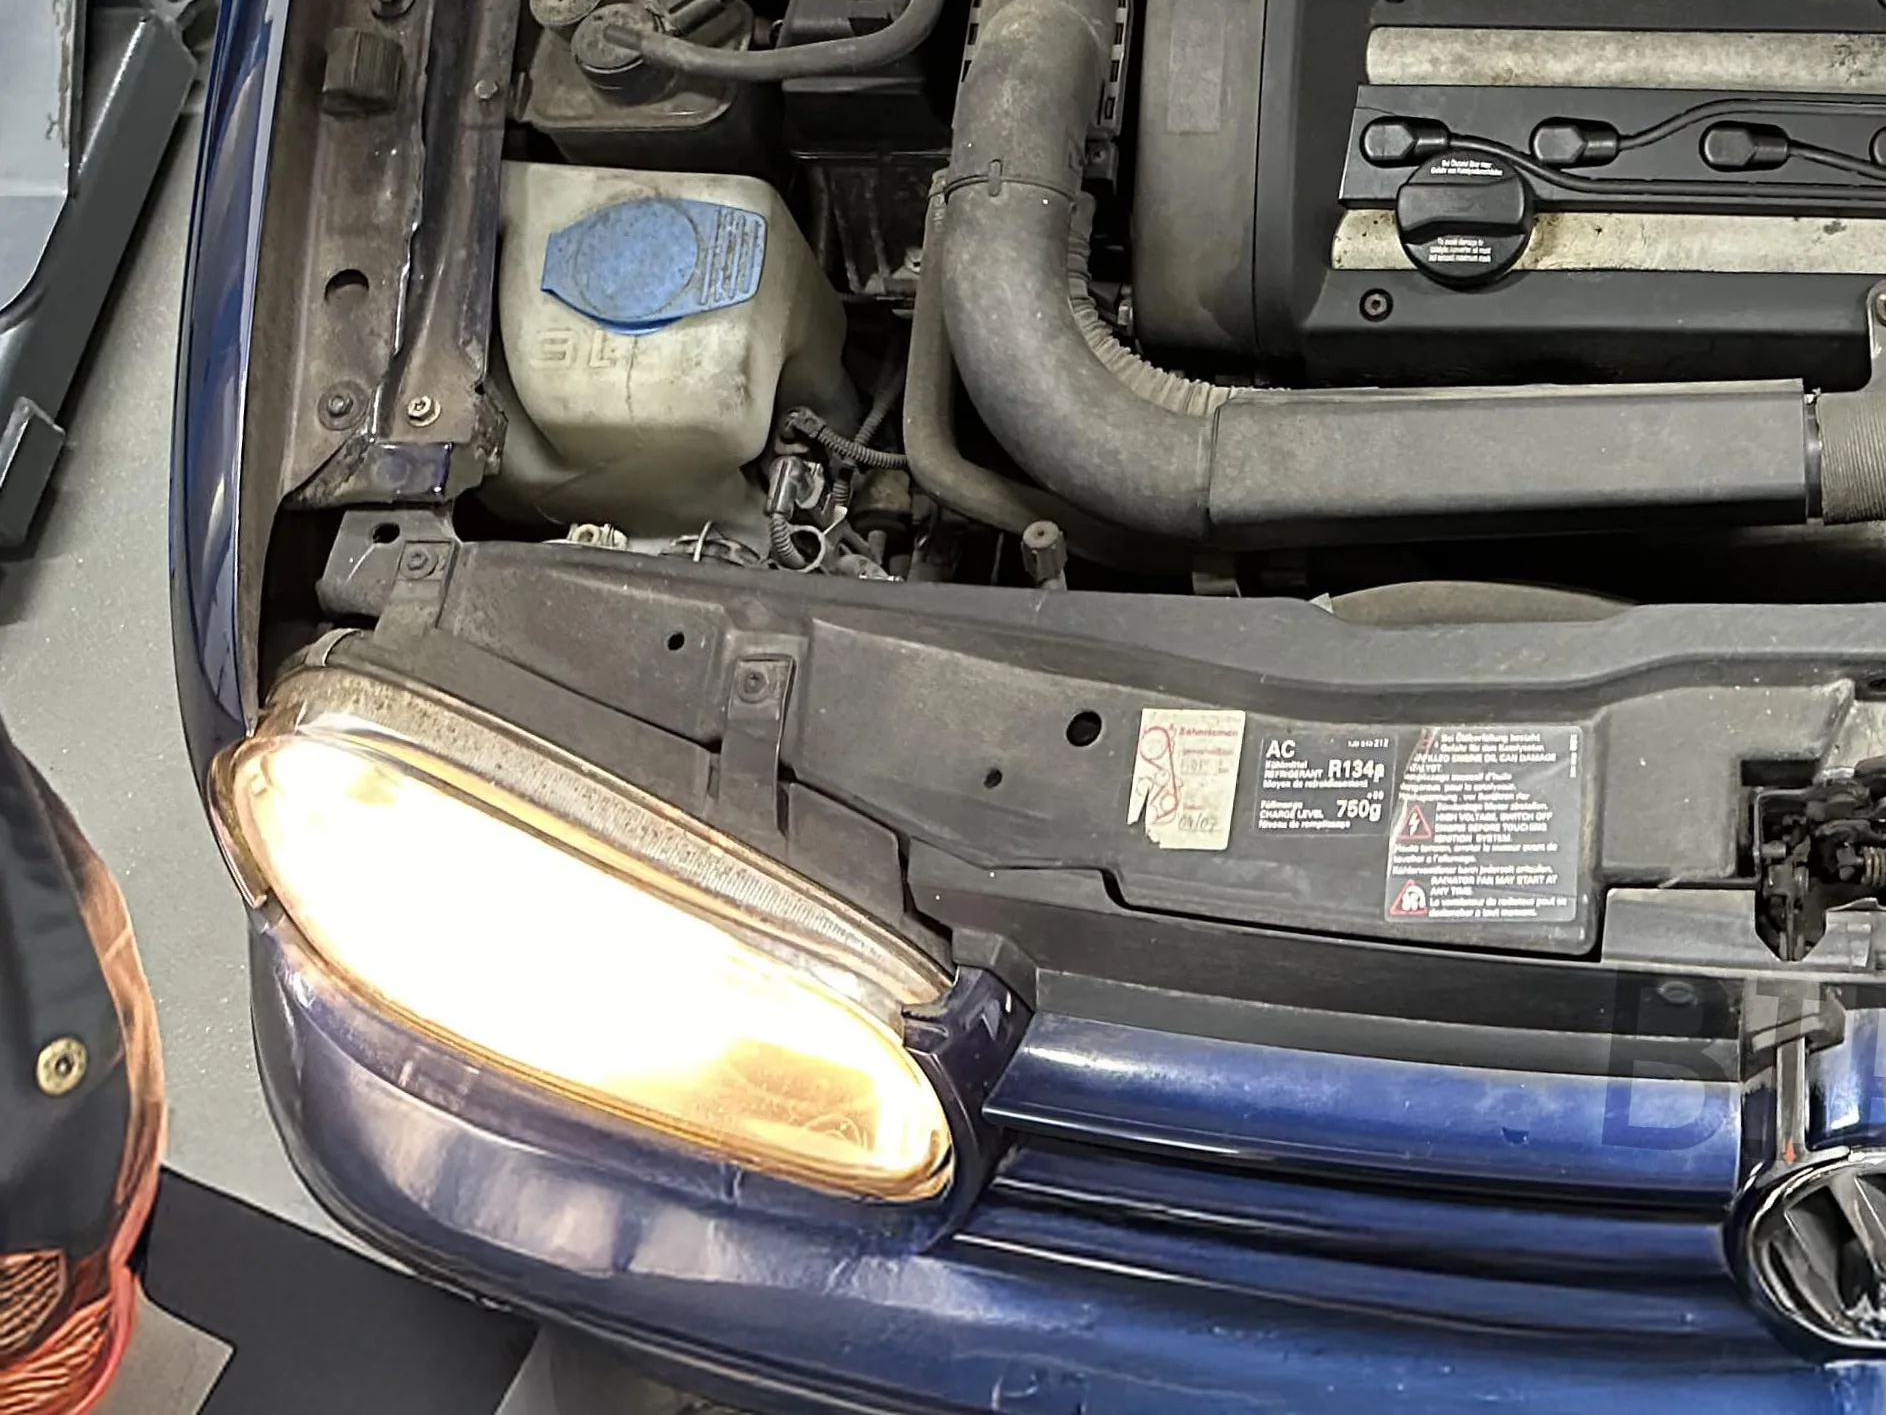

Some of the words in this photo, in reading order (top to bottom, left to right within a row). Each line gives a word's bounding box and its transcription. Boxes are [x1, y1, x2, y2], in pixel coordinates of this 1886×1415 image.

[1265, 739, 1296, 759] AC
[1500, 753, 1517, 763] CAN
[1519, 753, 1556, 763] DAMAGE
[1260, 809, 1296, 819] CHARGE
[1297, 809, 1324, 819] LEVEL
[1336, 799, 1382, 822] 750g
[1476, 875, 1494, 885] FAN
[1495, 875, 1515, 885] MAY
[1516, 875, 1545, 885] START
[1546, 875, 1558, 884] AT
[1430, 887, 1450, 896] ANY
